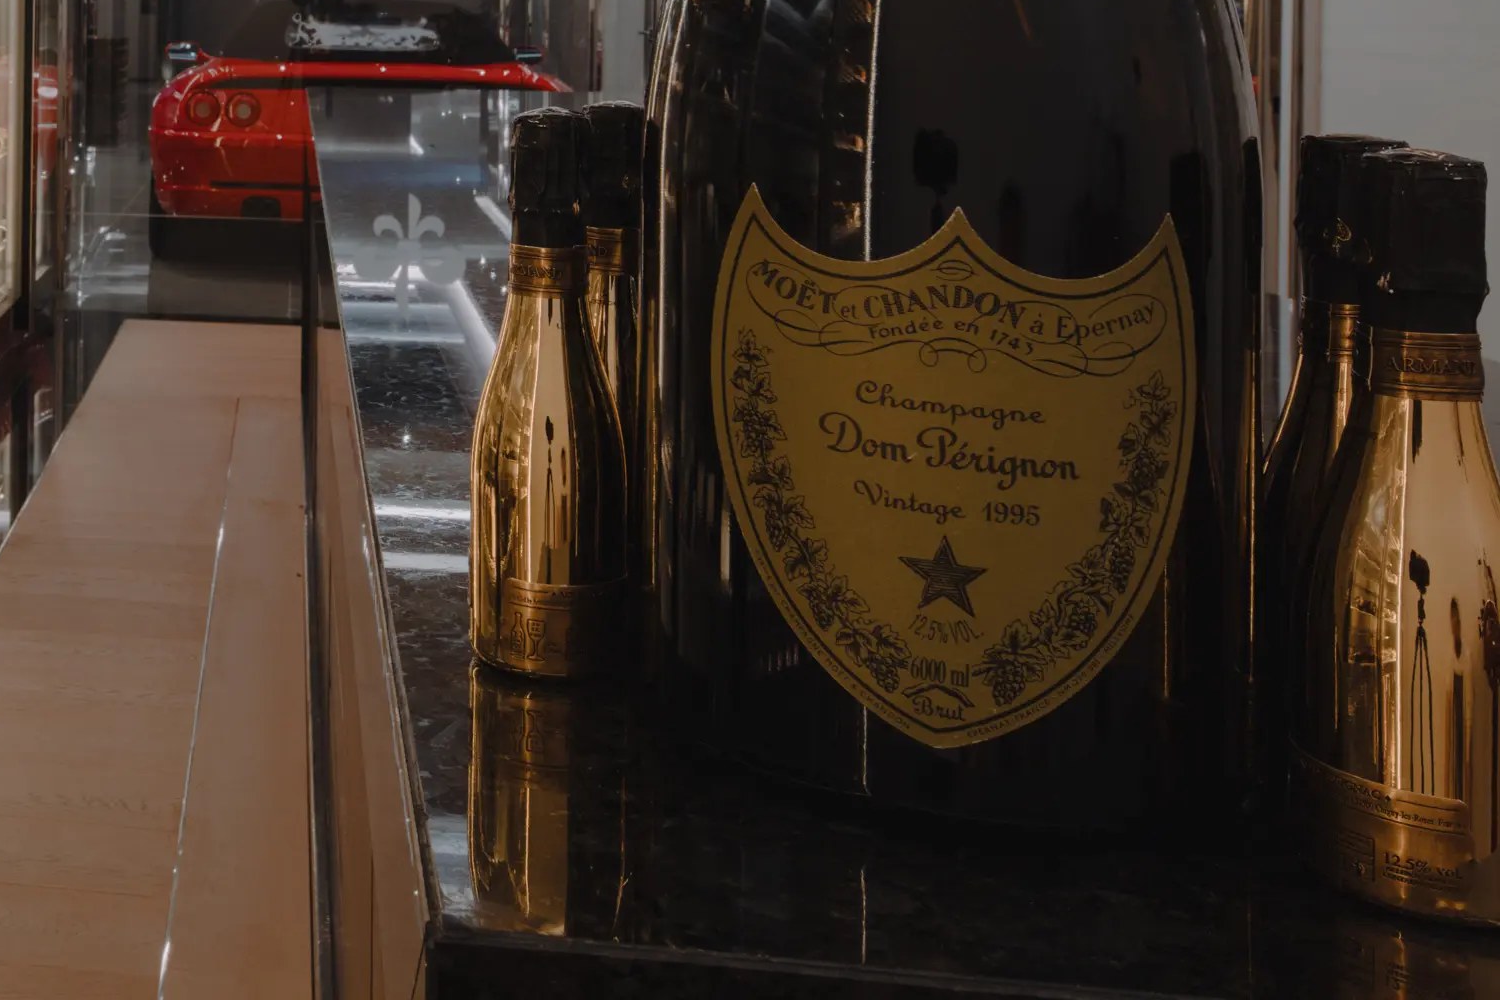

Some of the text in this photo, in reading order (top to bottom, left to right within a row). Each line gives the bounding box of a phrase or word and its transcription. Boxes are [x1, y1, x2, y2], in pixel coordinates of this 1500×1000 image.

[840, 304, 858, 319] et
[863, 284, 1027, 329] CHANDON
[1056, 301, 1155, 346] Epernay
[868, 316, 1035, 355] Fondée en 1743
[855, 380, 1046, 430] Champagne
[819, 411, 1081, 491] Dom Pérignon
[854, 479, 1042, 527] Vintage 1995
[910, 655, 969, 688] 6000 ml
[912, 695, 967, 722] Brut
